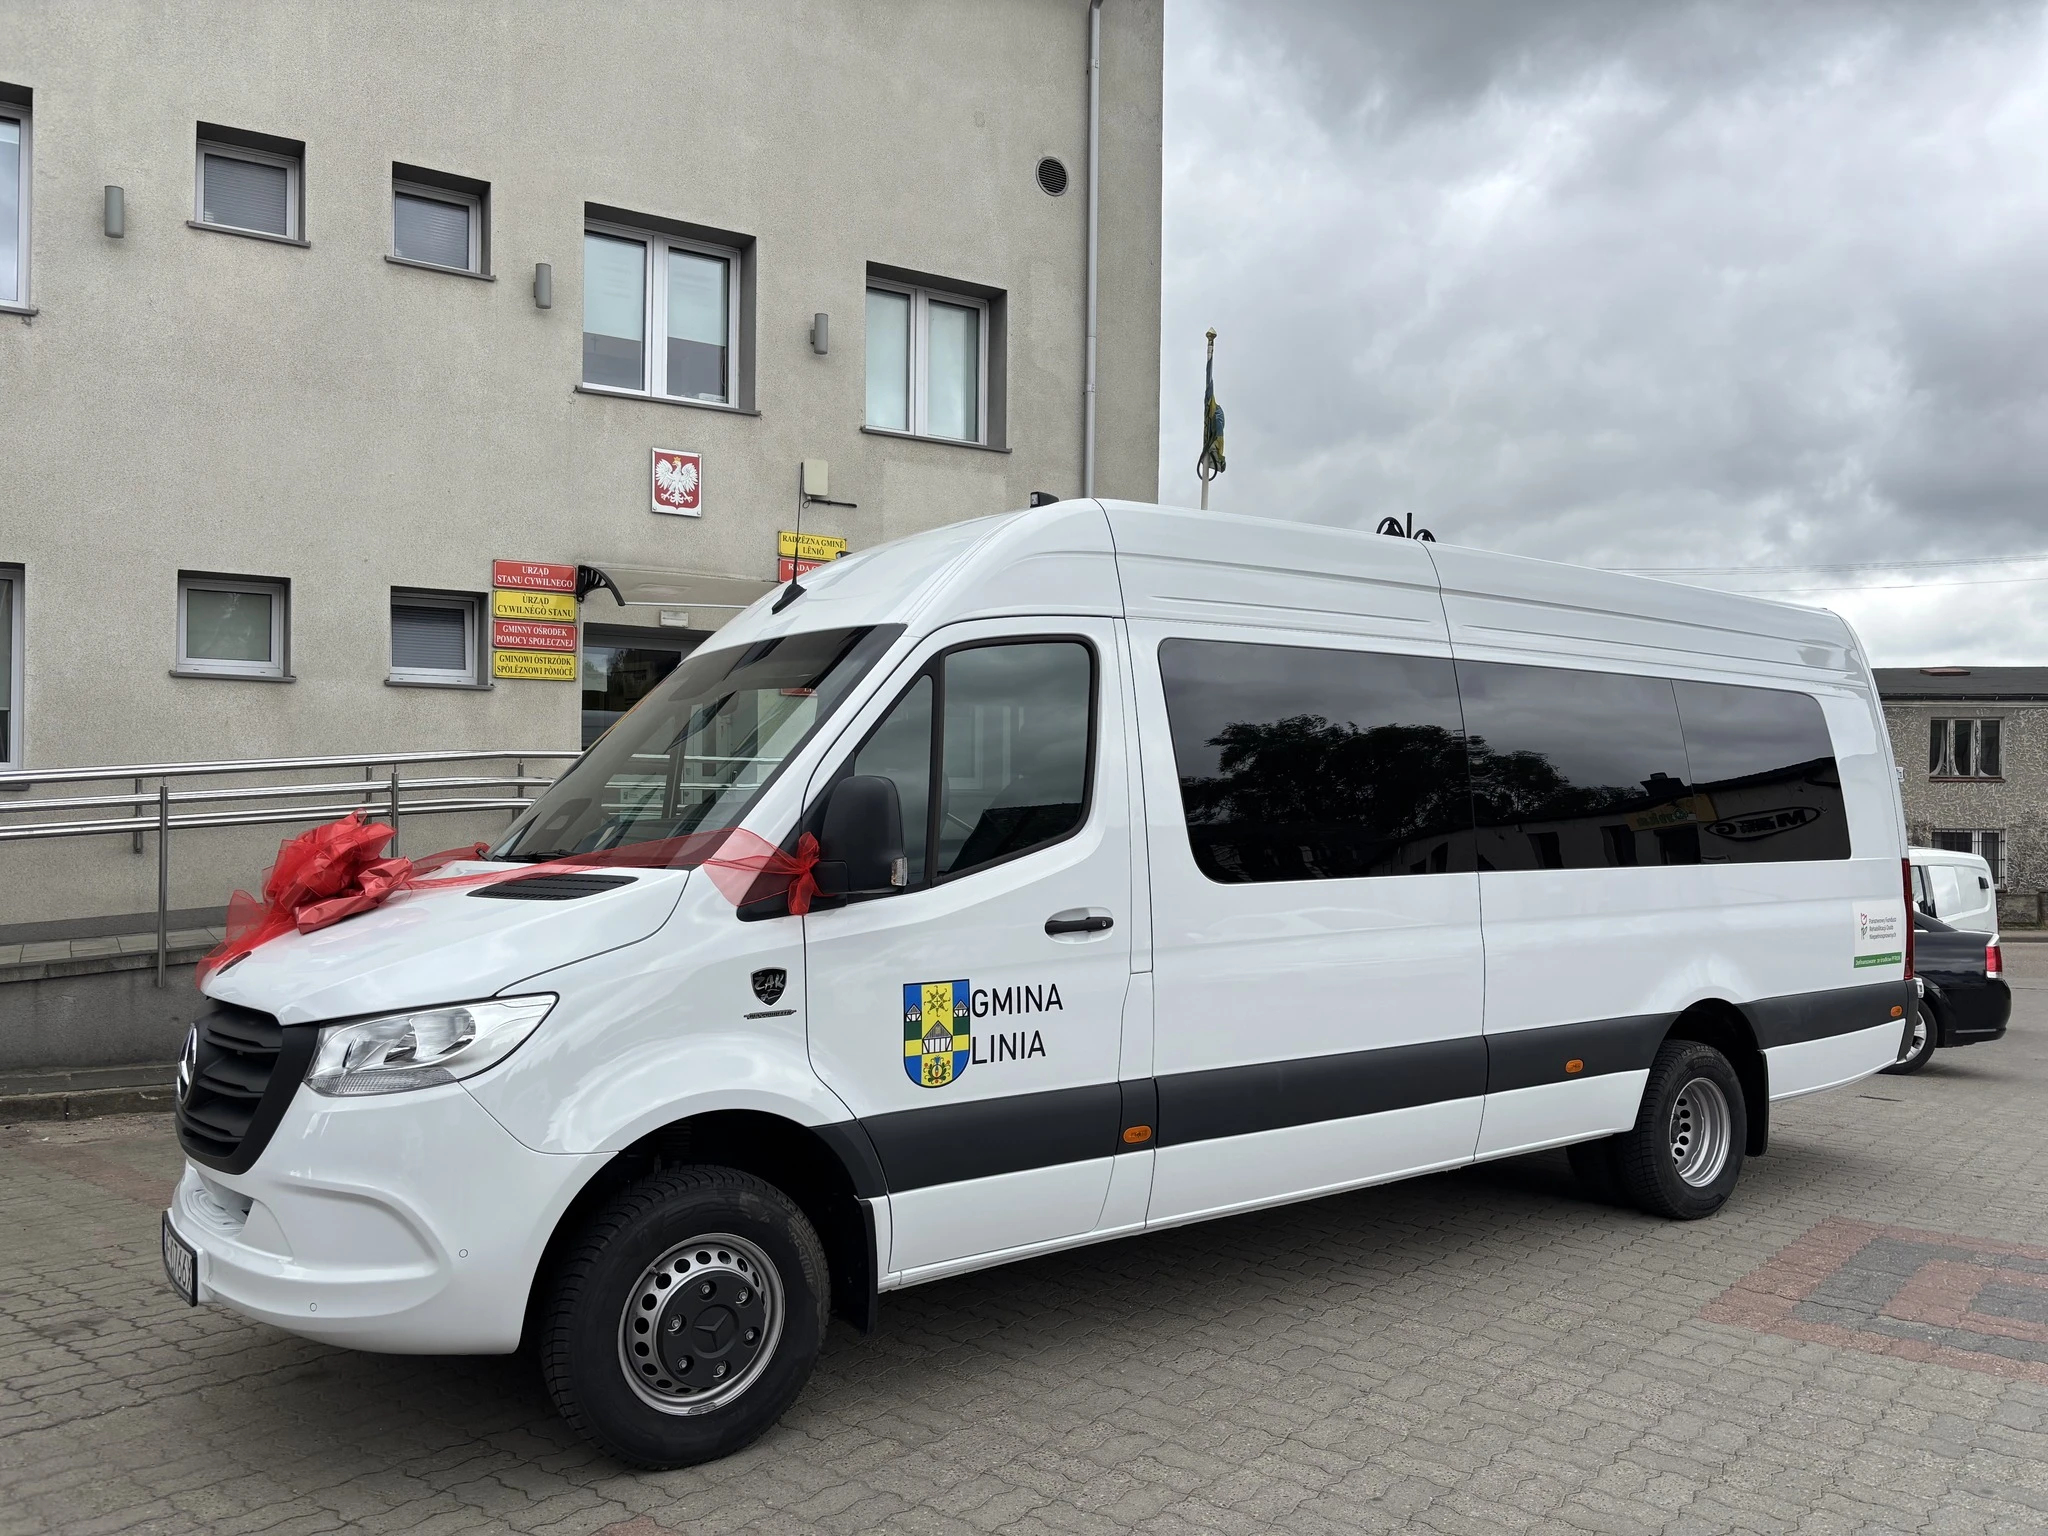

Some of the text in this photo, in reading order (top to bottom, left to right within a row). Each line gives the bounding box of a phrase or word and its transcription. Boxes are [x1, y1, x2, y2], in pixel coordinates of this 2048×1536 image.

[522, 566, 549, 577] URZĄD
[497, 575, 573, 588] STANU CYWILNEGO
[548, 609, 573, 617] STANU
[502, 625, 567, 636] GMINNY OŚRODEK
[496, 635, 528, 645] POMOCY
[499, 654, 533, 664] GMINOWI
[971, 983, 1064, 1018] GMINA
[971, 1030, 1046, 1065] LINIA
